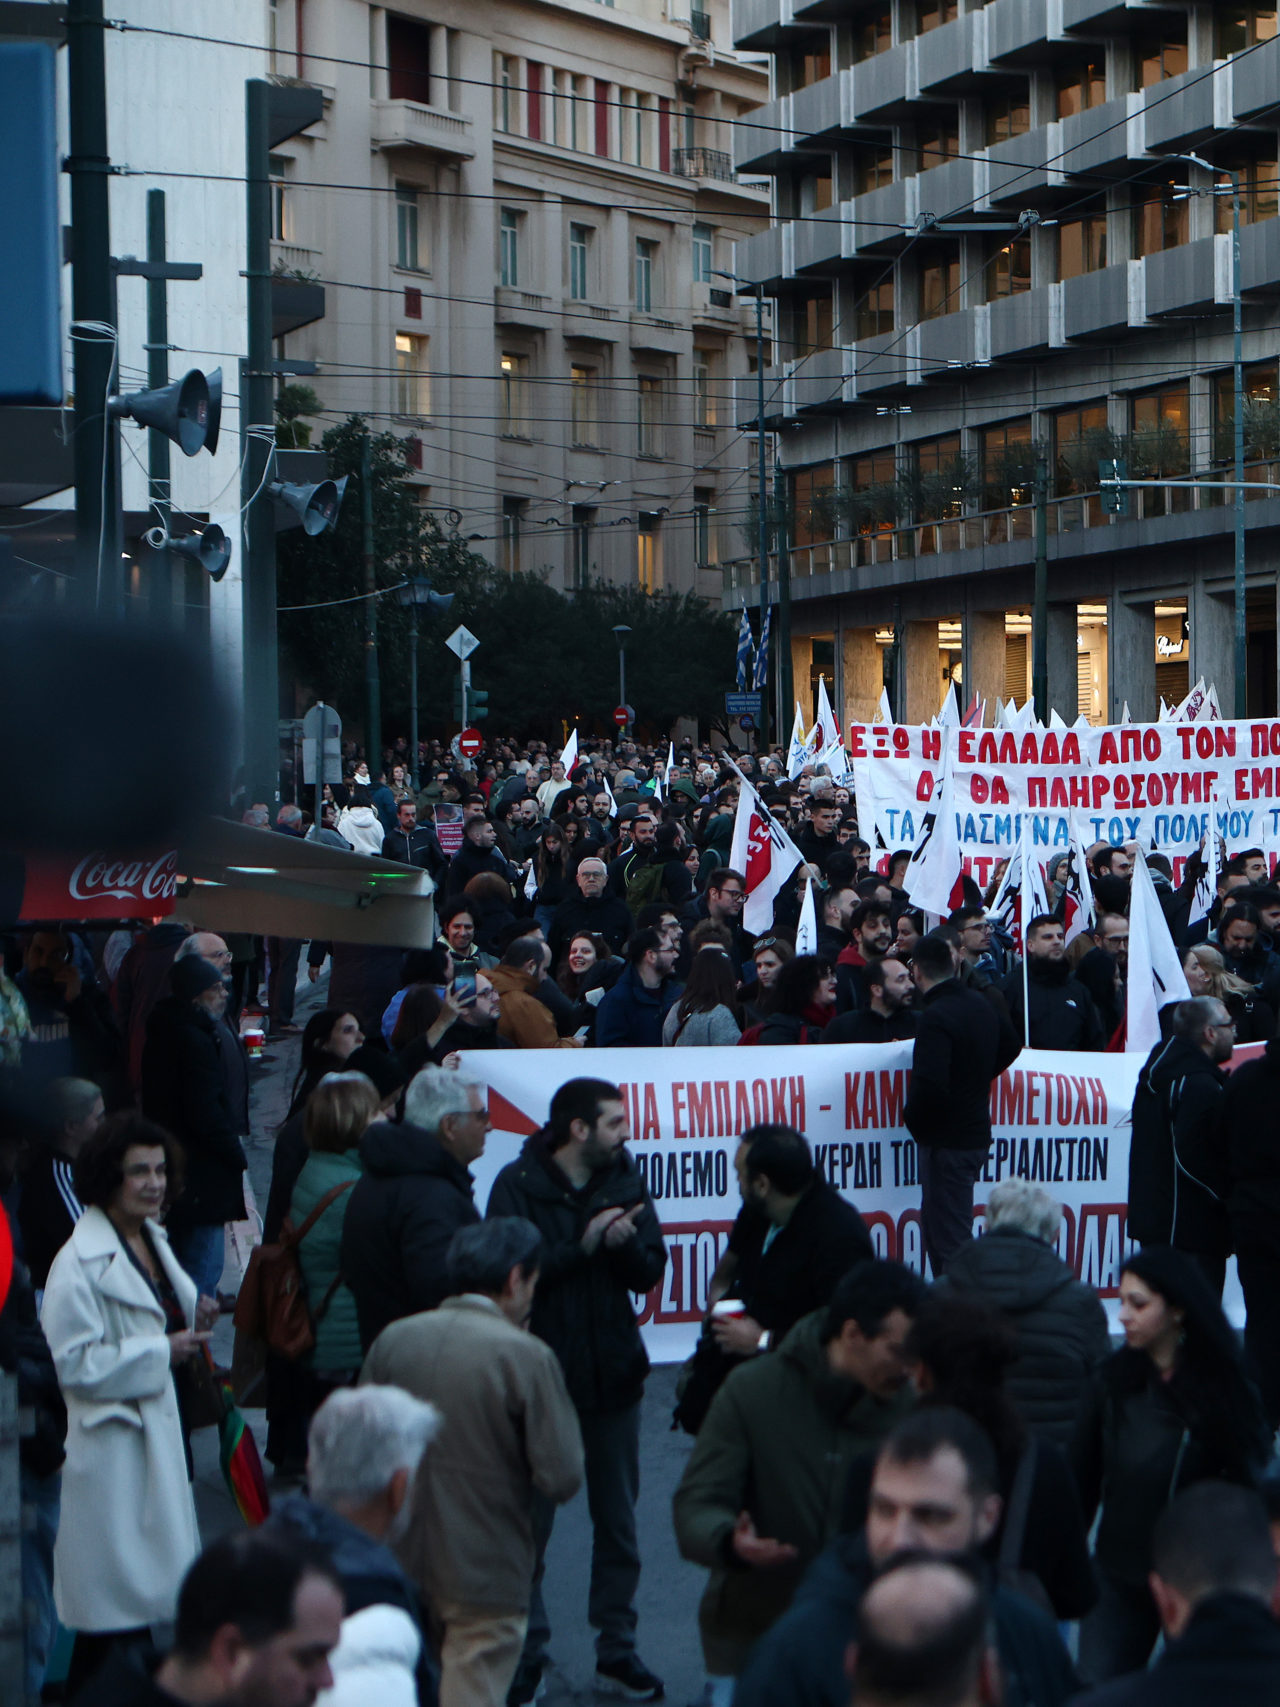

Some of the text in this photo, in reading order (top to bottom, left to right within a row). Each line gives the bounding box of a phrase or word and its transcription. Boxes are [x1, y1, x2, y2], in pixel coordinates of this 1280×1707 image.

[851, 726, 910, 758] ΕΞΩ
[958, 731, 1081, 764] ΕΛΛΑΔΑ
[1098, 727, 1161, 765] ΑΠΟ
[1177, 726, 1236, 760] ΤΟΝ
[970, 773, 1009, 806] ΘΑ
[885, 809, 915, 842] ΤΑ
[1089, 816, 1141, 847] ΤΟΥ
[69, 850, 177, 900] Coca-Co
[671, 1075, 806, 1139] ΕΜΠΛΟΚΗ
[974, 1136, 1109, 1183] ΕΡΙΑΛΙΣΤΩΝ
